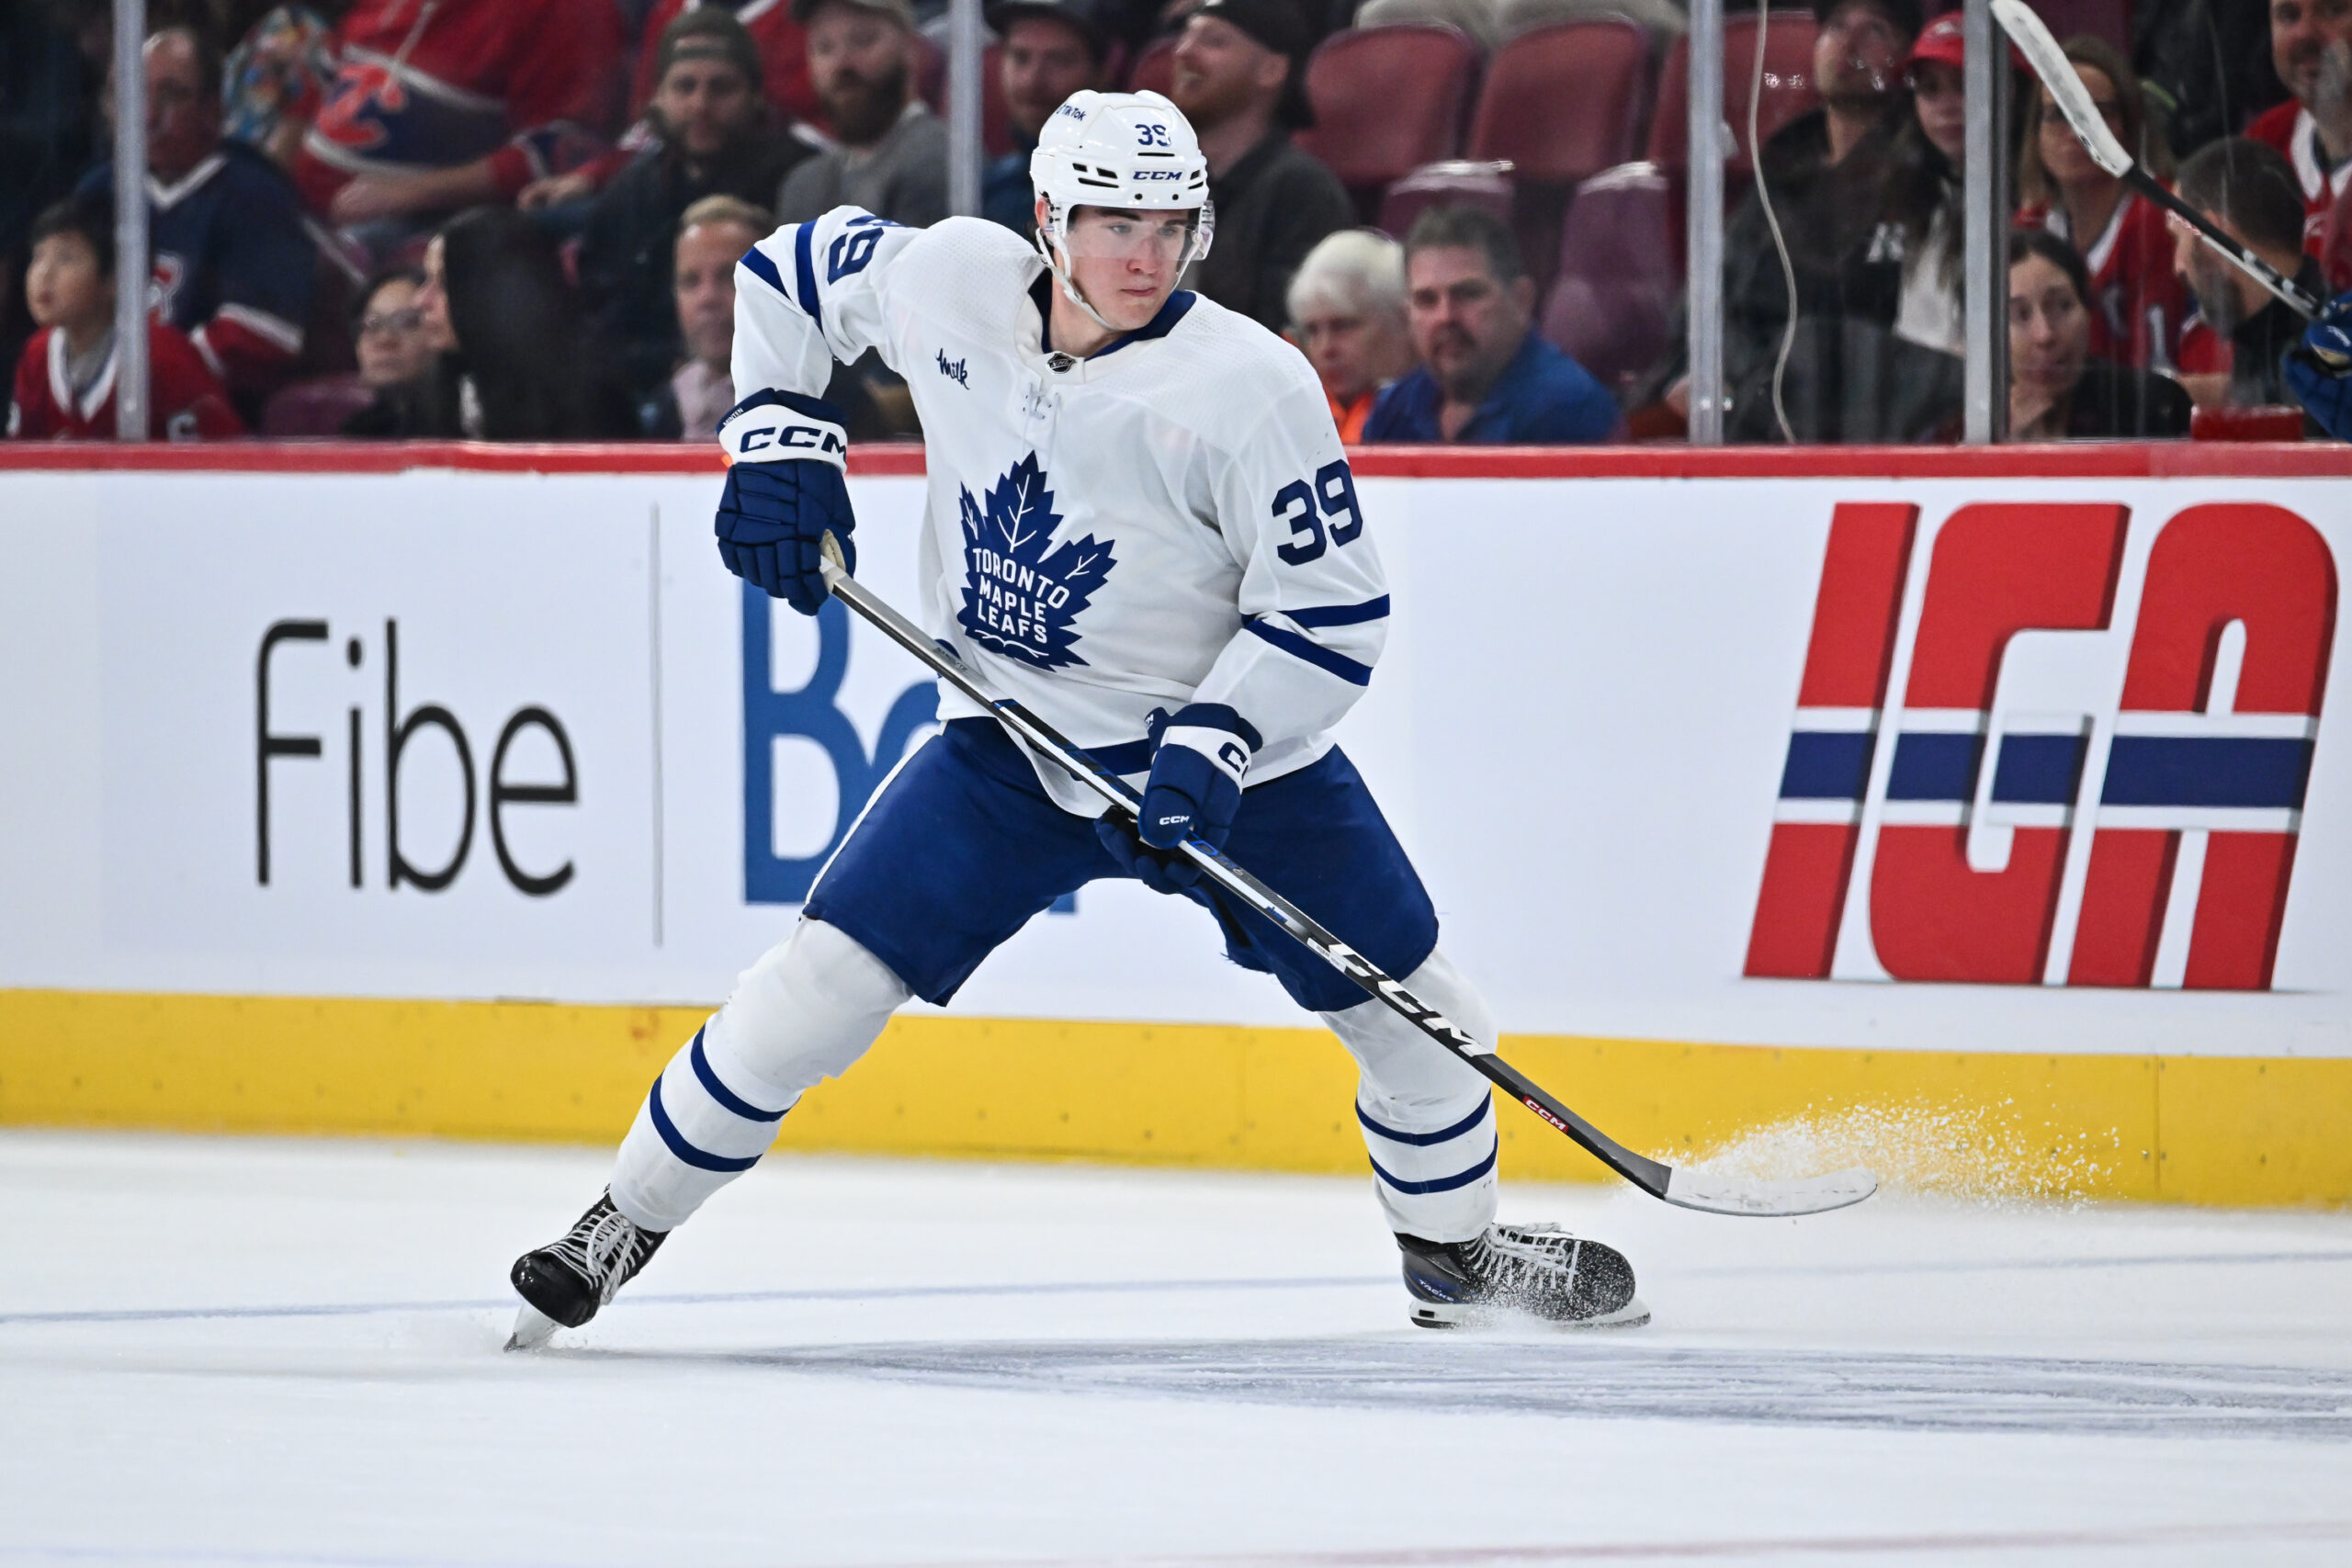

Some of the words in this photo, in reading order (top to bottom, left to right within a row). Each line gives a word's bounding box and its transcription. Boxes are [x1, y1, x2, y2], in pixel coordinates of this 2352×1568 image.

[1135, 123, 1171, 147] 39
[1133, 171, 1182, 181] CCM
[740, 425, 847, 463] CCM
[1271, 458, 1363, 567] 39
[972, 547, 1070, 610] TORONTO
[978, 575, 1047, 624] MAPLE
[977, 598, 1048, 645] LEAFS
[255, 617, 579, 898] Fibe
[1218, 741, 1250, 780] C
[1742, 502, 2339, 991] IGA
[1159, 815, 1191, 826] CCM
[1329, 942, 1496, 1058] CCM
[1525, 1099, 1566, 1131] CCM
